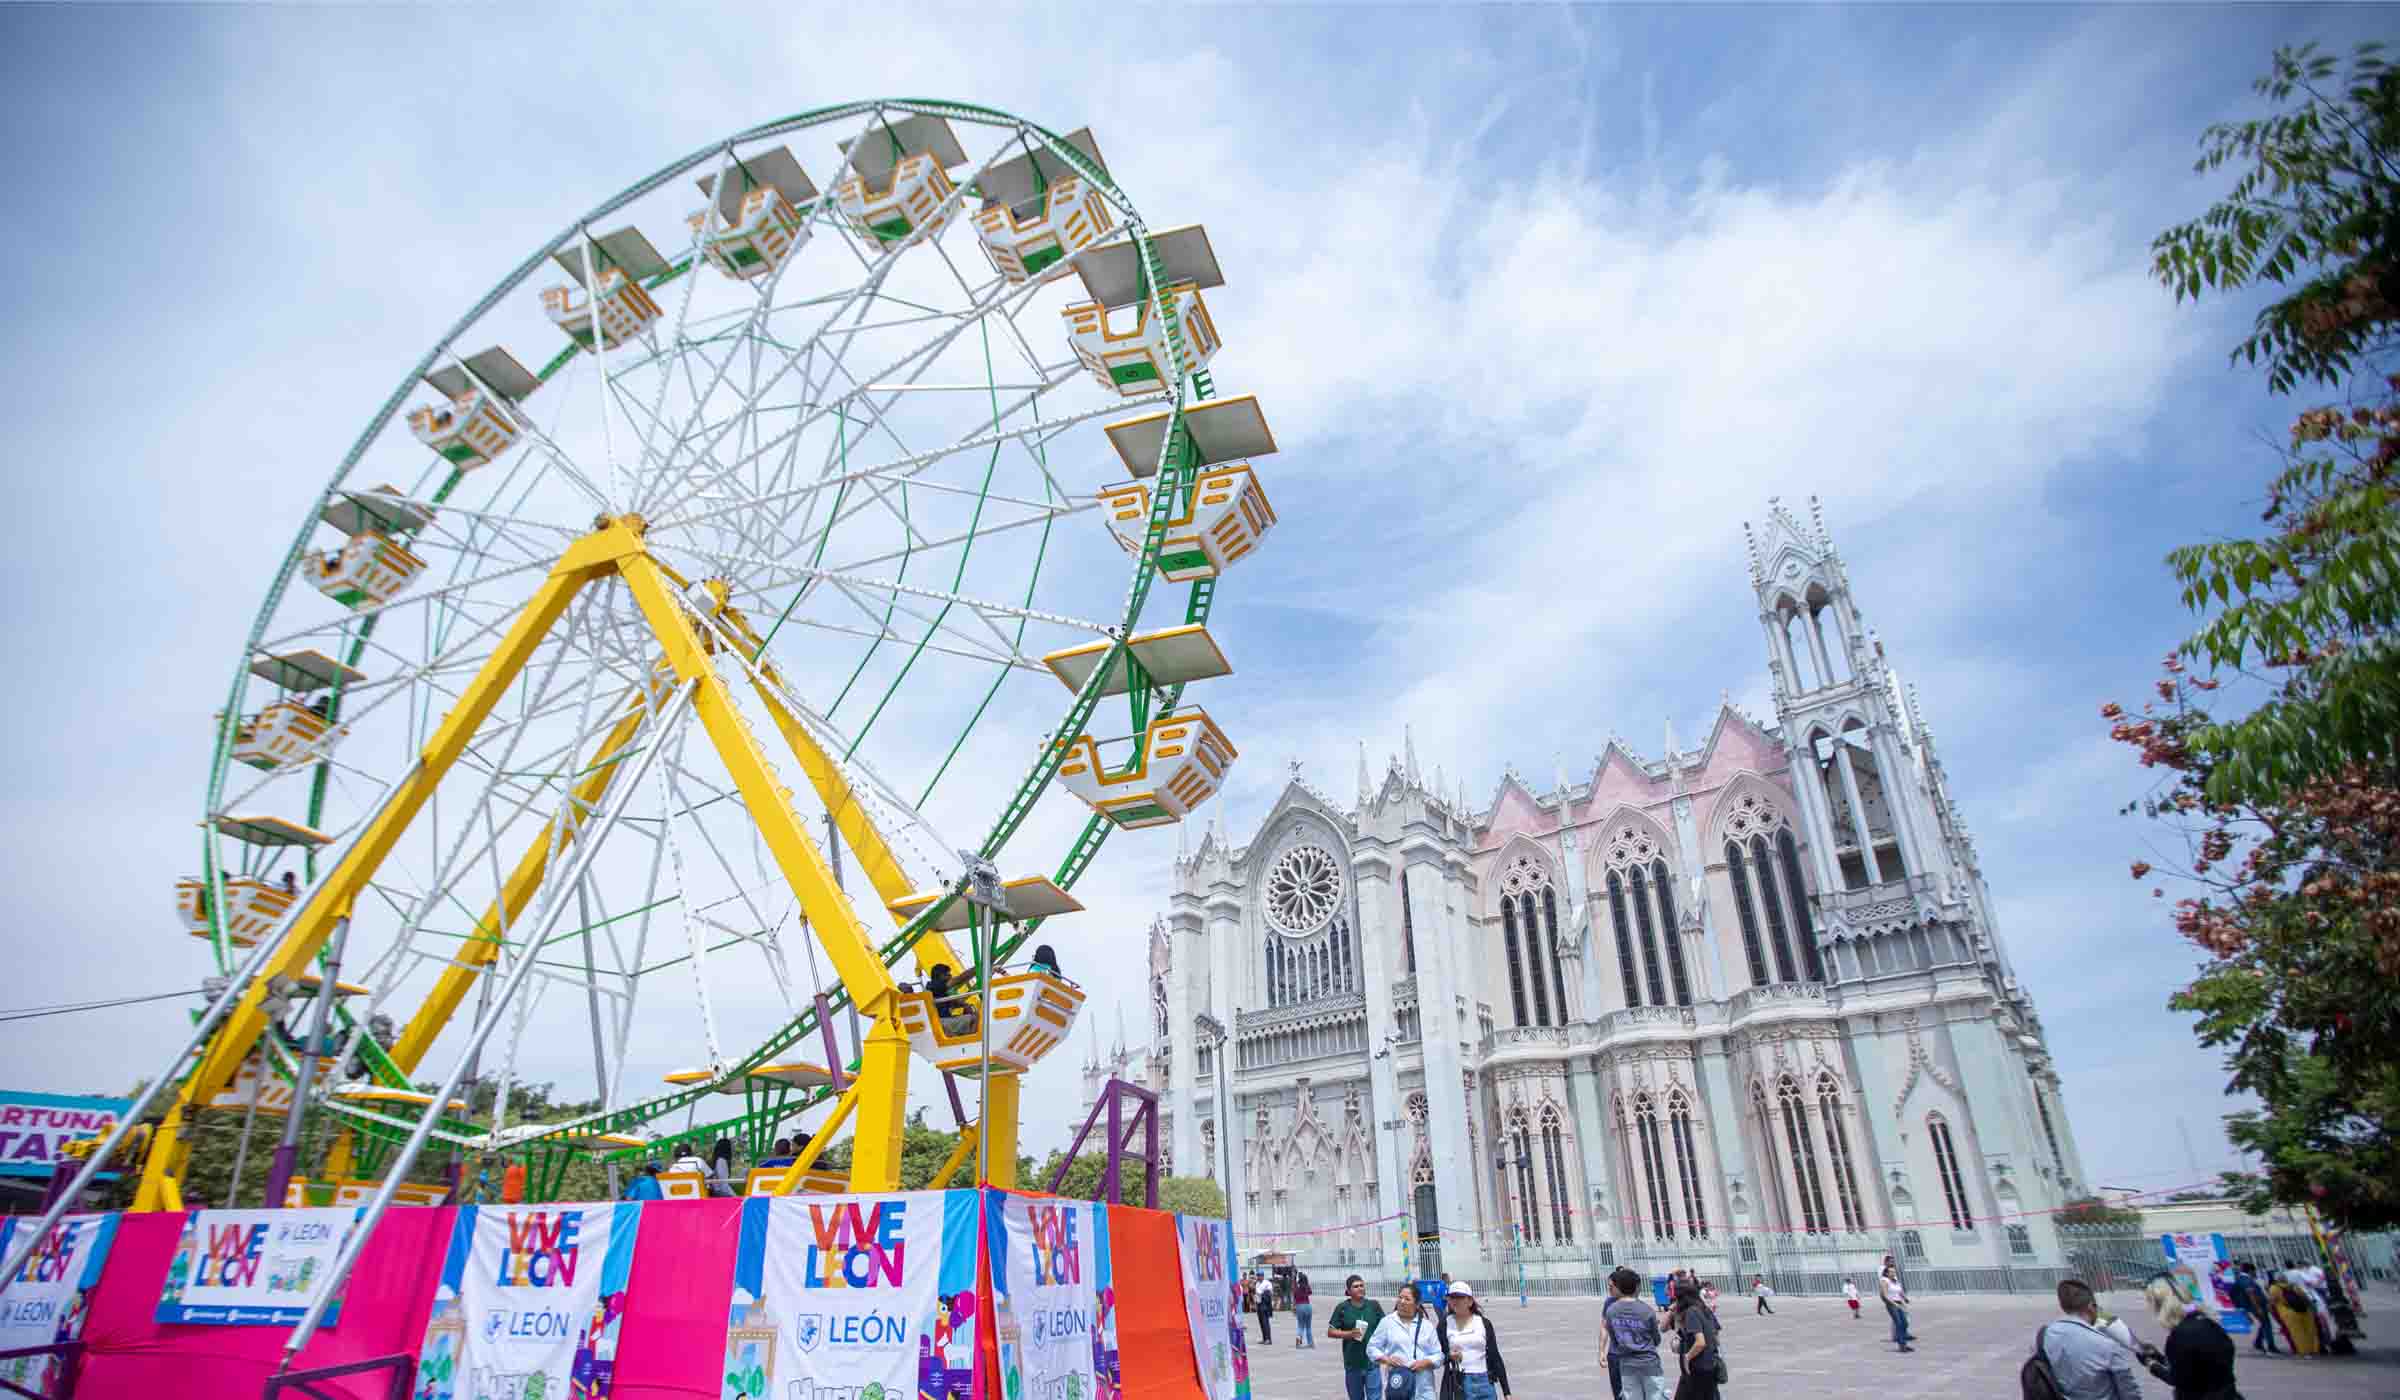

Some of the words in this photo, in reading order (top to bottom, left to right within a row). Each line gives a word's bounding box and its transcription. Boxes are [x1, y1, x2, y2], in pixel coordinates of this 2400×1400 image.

[210, 1223, 270, 1260] VIVE
[506, 1210, 583, 1255] VIVE
[808, 1201, 906, 1251] VIVE
[1027, 1205, 1078, 1250] VIVE
[508, 1306, 570, 1337] LEÓN
[828, 1308, 906, 1343] LEÓN
[1049, 1304, 1086, 1337] LEÓN
